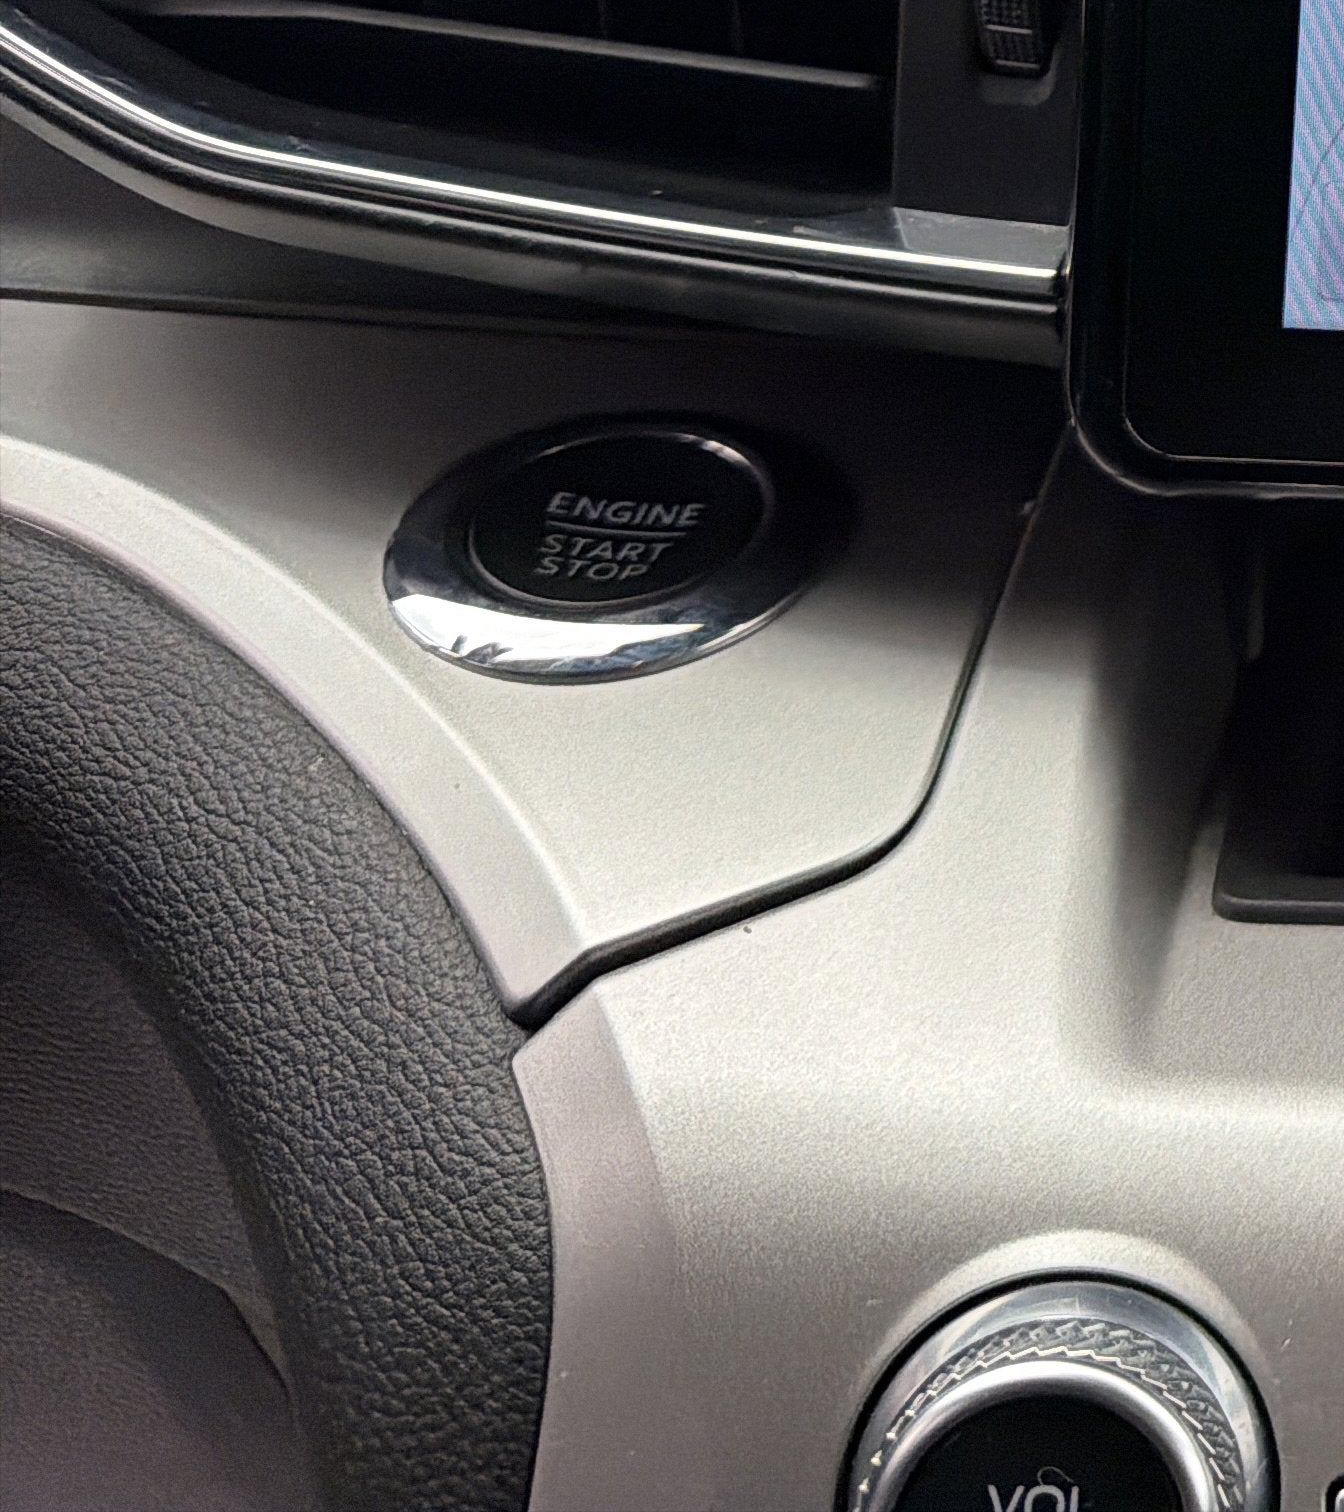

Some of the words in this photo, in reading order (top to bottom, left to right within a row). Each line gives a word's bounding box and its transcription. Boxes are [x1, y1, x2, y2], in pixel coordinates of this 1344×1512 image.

[547, 492, 706, 527] ENGINE
[538, 534, 673, 563] START
[533, 557, 650, 581] STOP
